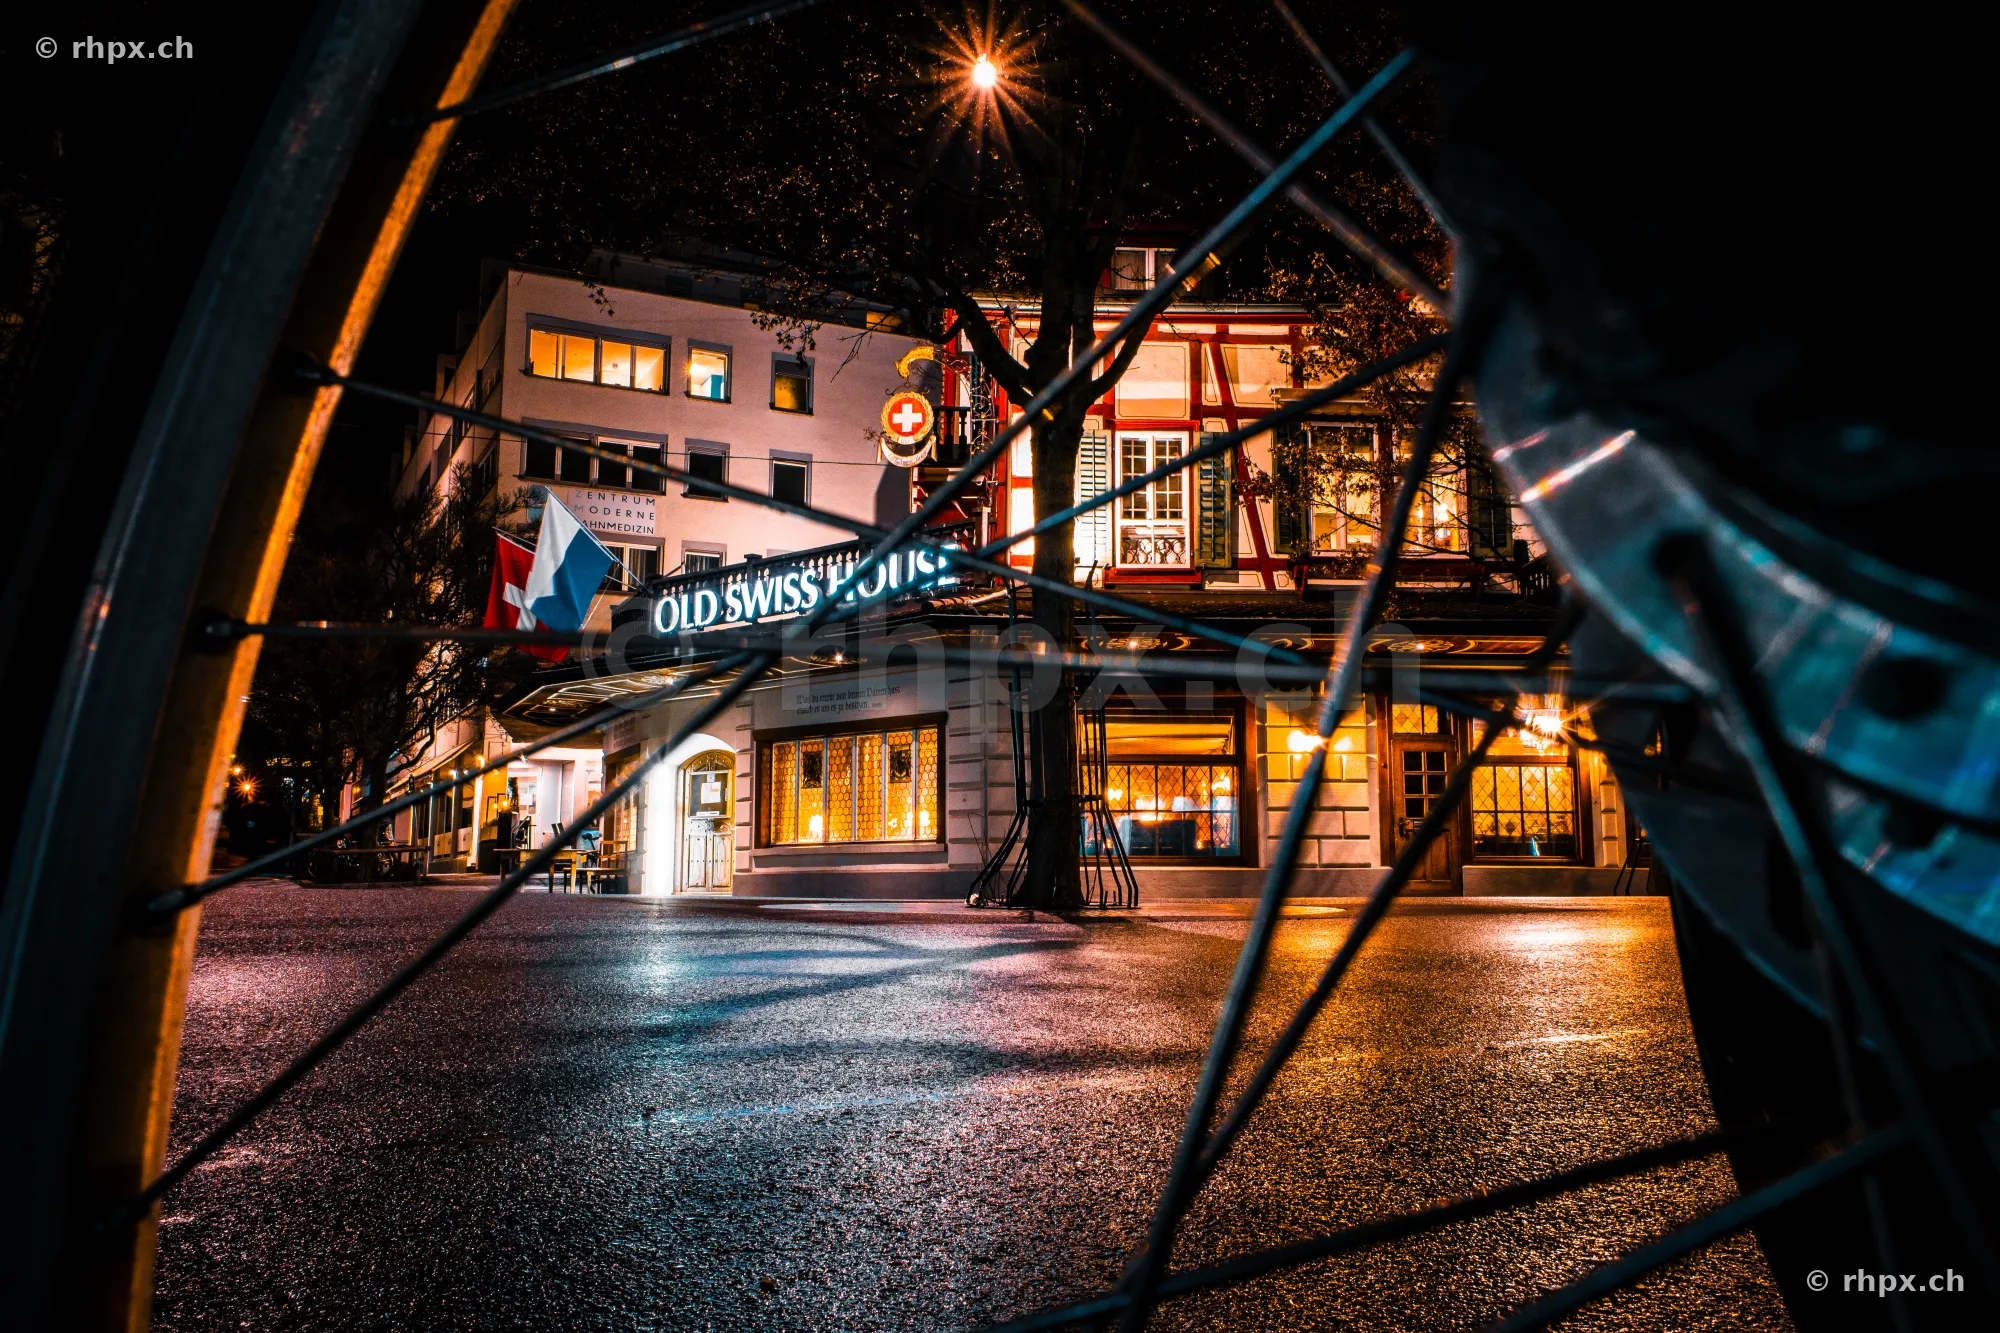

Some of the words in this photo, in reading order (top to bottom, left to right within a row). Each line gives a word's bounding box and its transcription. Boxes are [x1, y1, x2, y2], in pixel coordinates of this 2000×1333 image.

[576, 489, 655, 506] ZENTRUM
[574, 504, 654, 520] MODERNE
[580, 520, 654, 535] AHNMEDIZIN
[655, 590, 718, 632] OLD
[725, 569, 819, 622] SWISS
